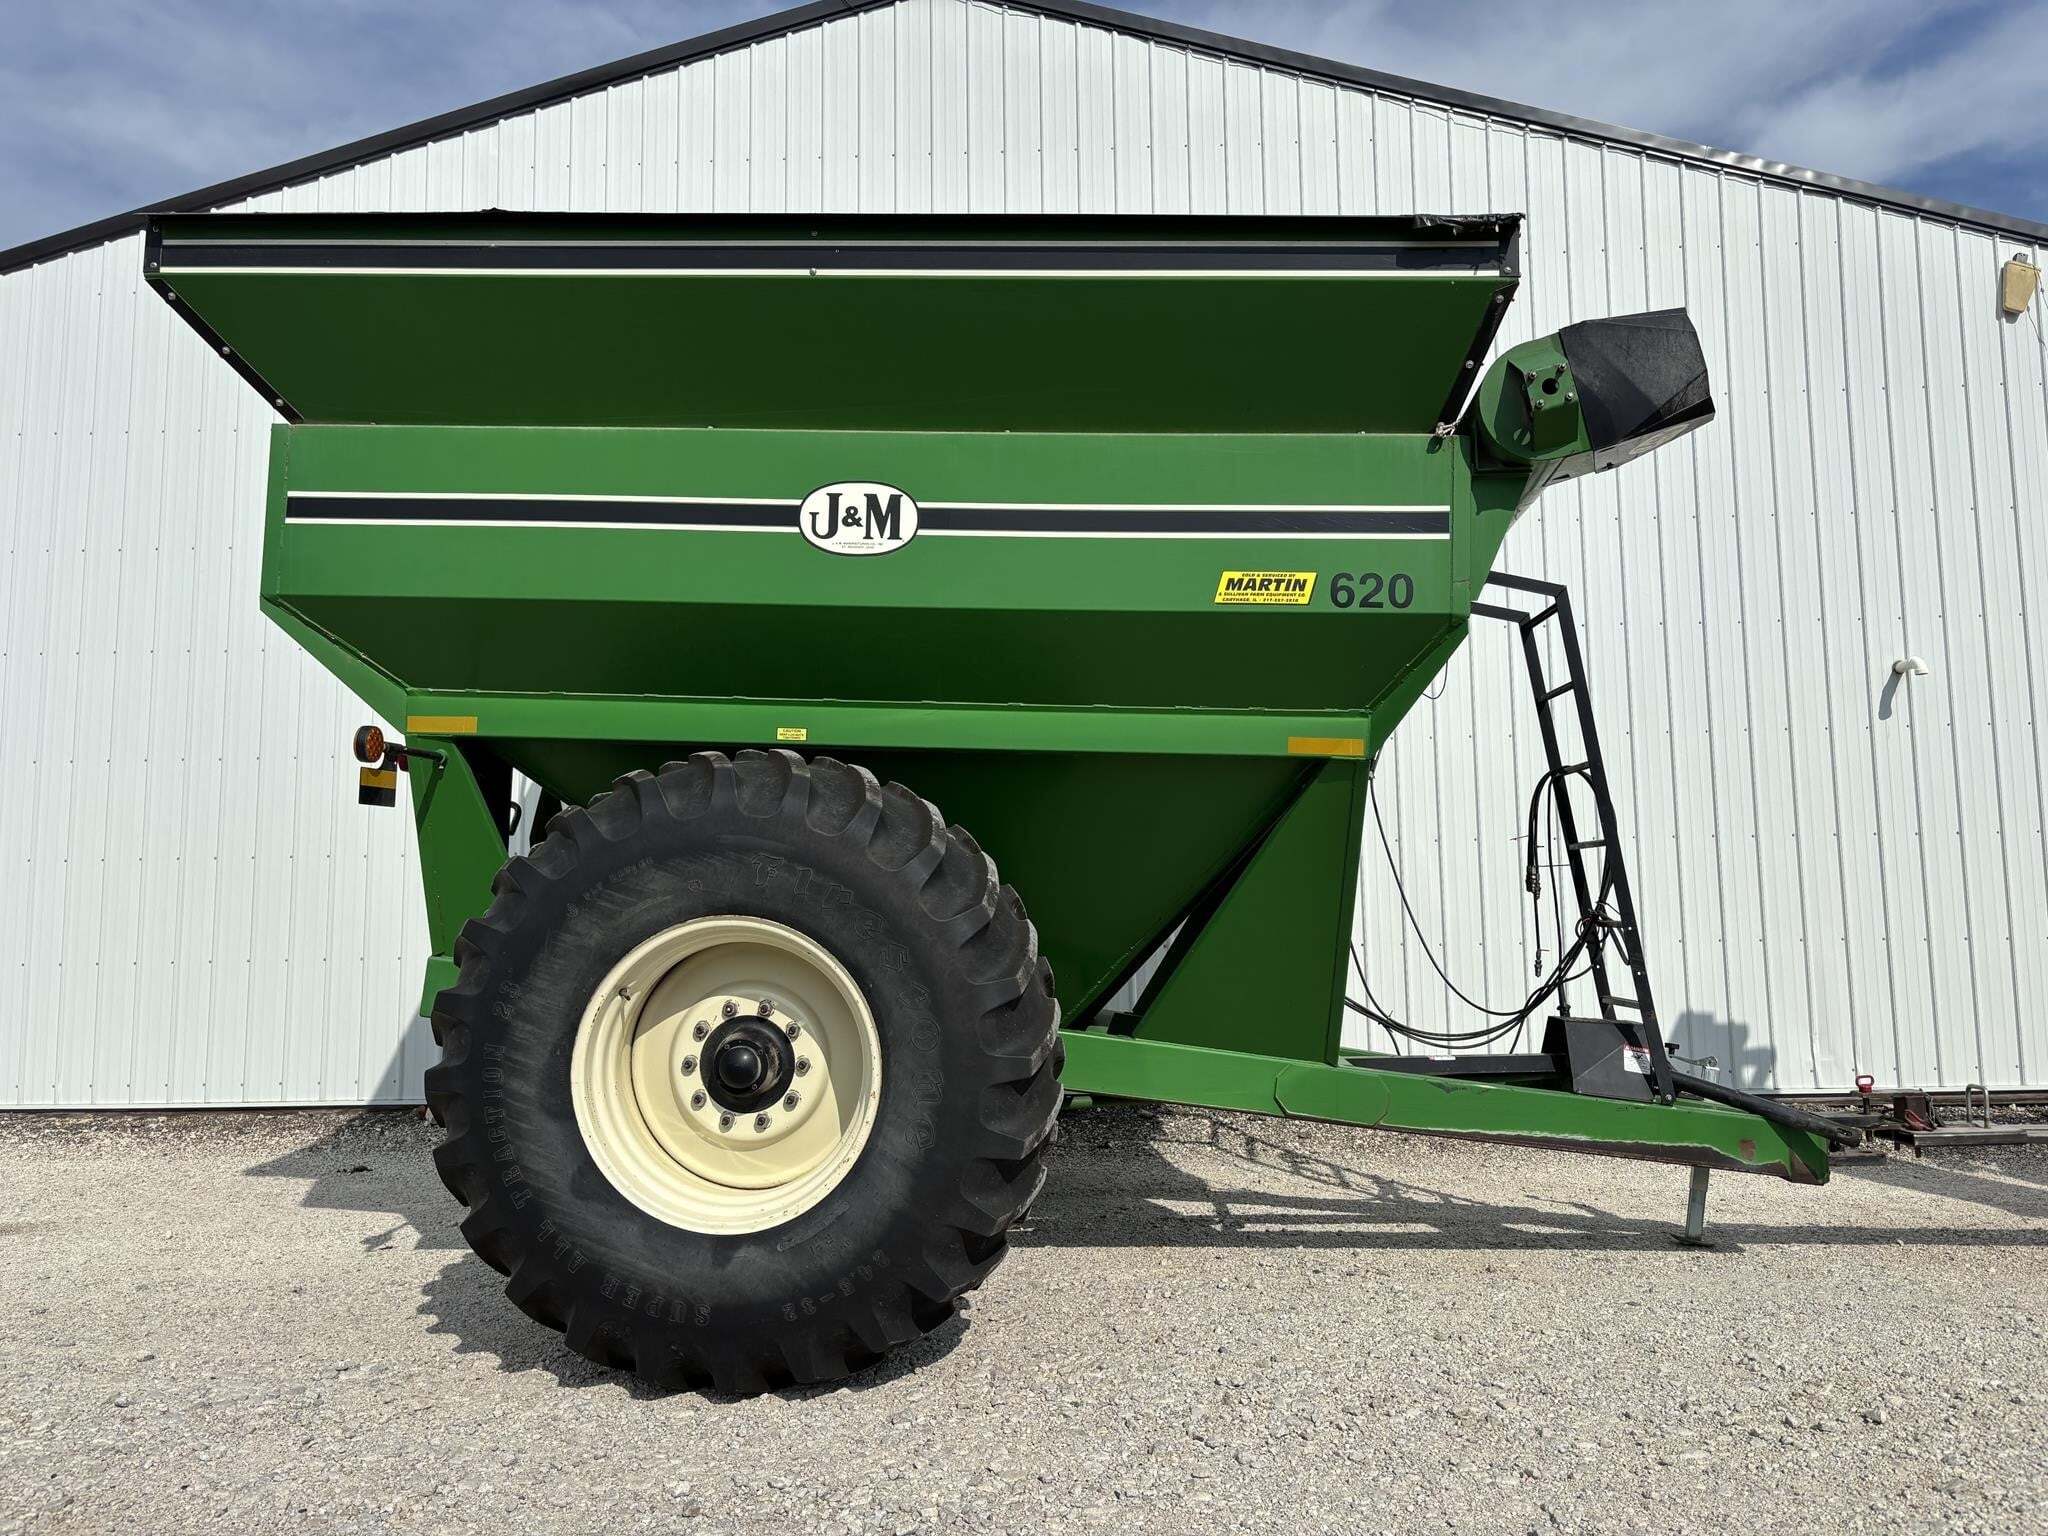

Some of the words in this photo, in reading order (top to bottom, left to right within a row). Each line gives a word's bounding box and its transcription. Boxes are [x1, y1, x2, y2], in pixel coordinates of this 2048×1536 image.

[809, 493, 903, 540] J&M
[1225, 578, 1308, 592] MARTIN
[1330, 572, 1414, 609] 620
[480, 1041, 533, 1210] TRACTION
[535, 1215, 590, 1275] ALL
[600, 1275, 712, 1328] SUPER
